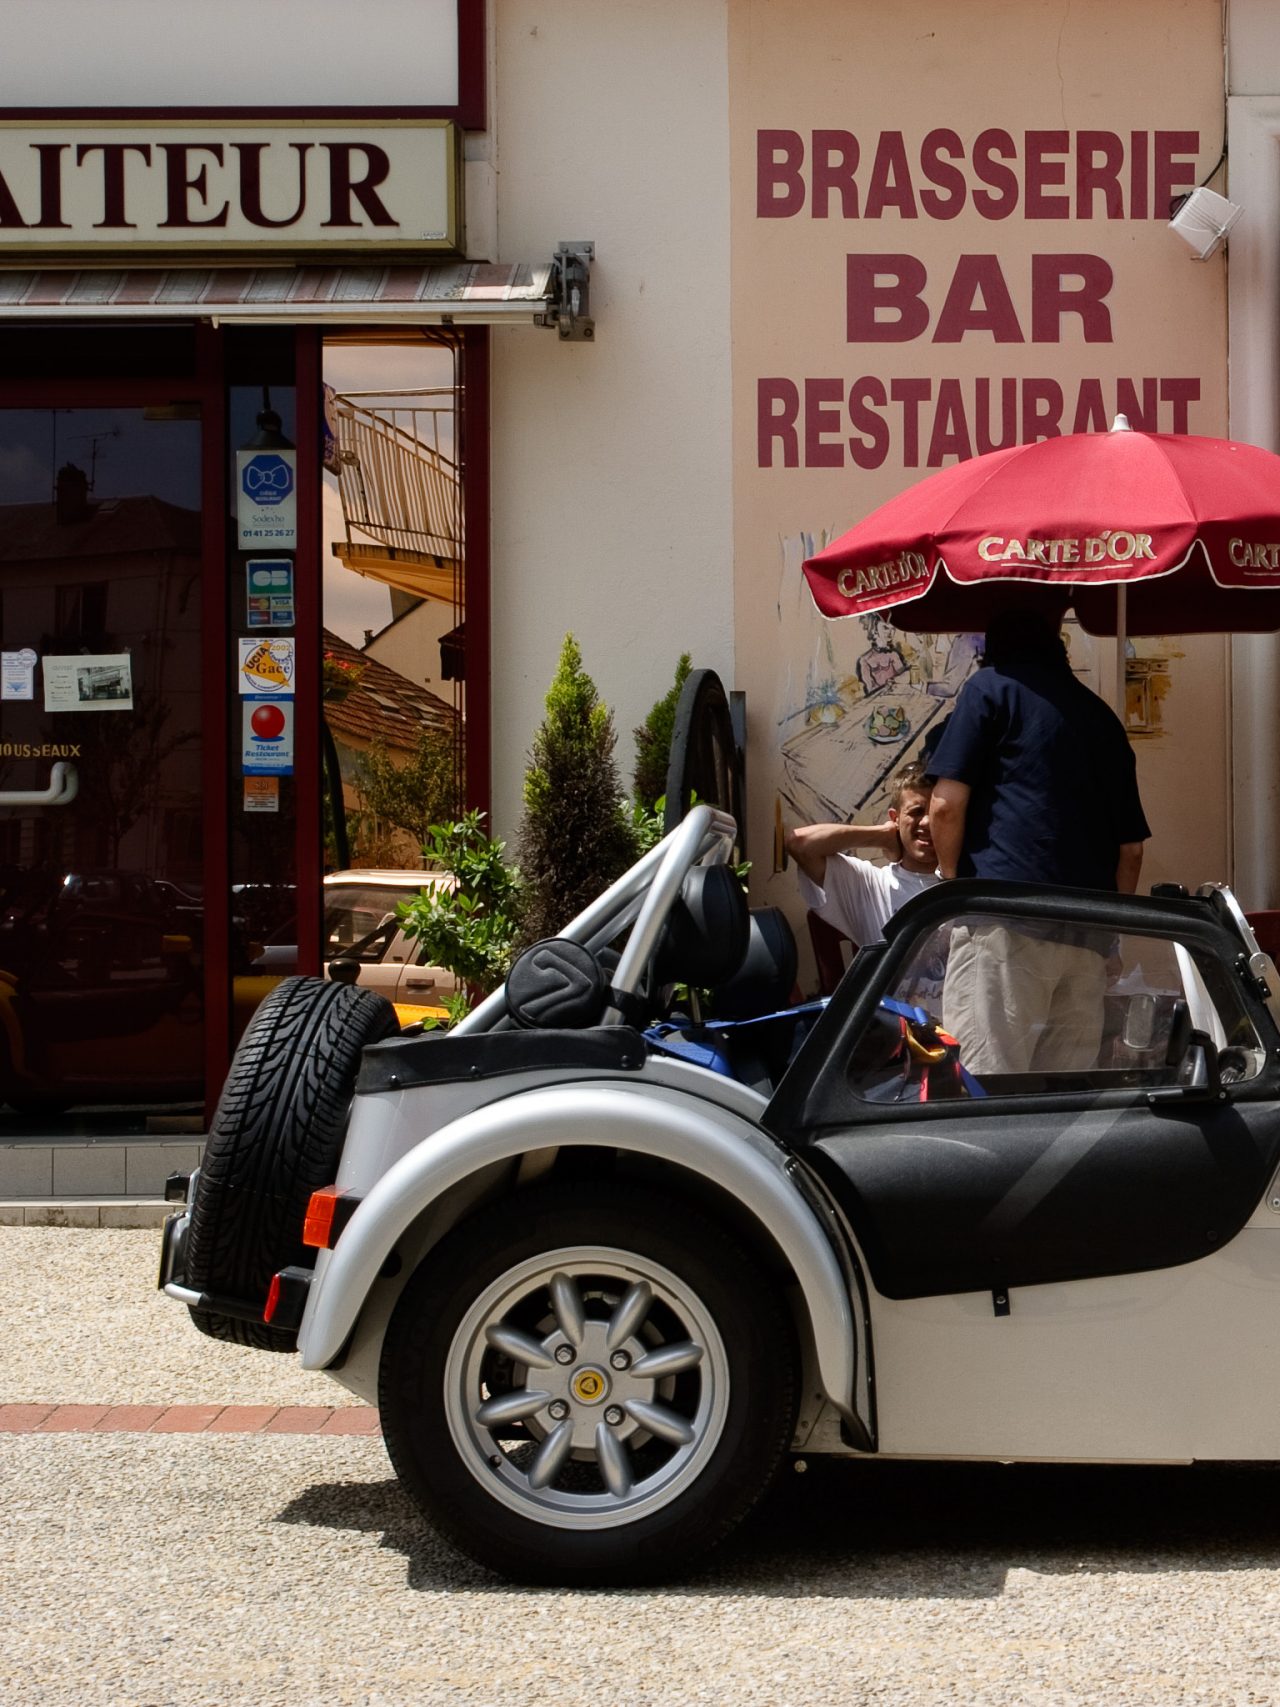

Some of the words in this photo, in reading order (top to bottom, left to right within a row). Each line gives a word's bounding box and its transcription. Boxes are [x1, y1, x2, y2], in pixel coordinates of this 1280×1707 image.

[756, 127, 1200, 221] BRASSERIE
[845, 253, 1114, 344] BAR
[977, 536, 1081, 565] CARTE
[1084, 530, 1157, 563] D'OR
[836, 560, 899, 598] CARTE
[245, 647, 268, 669] UCIA
